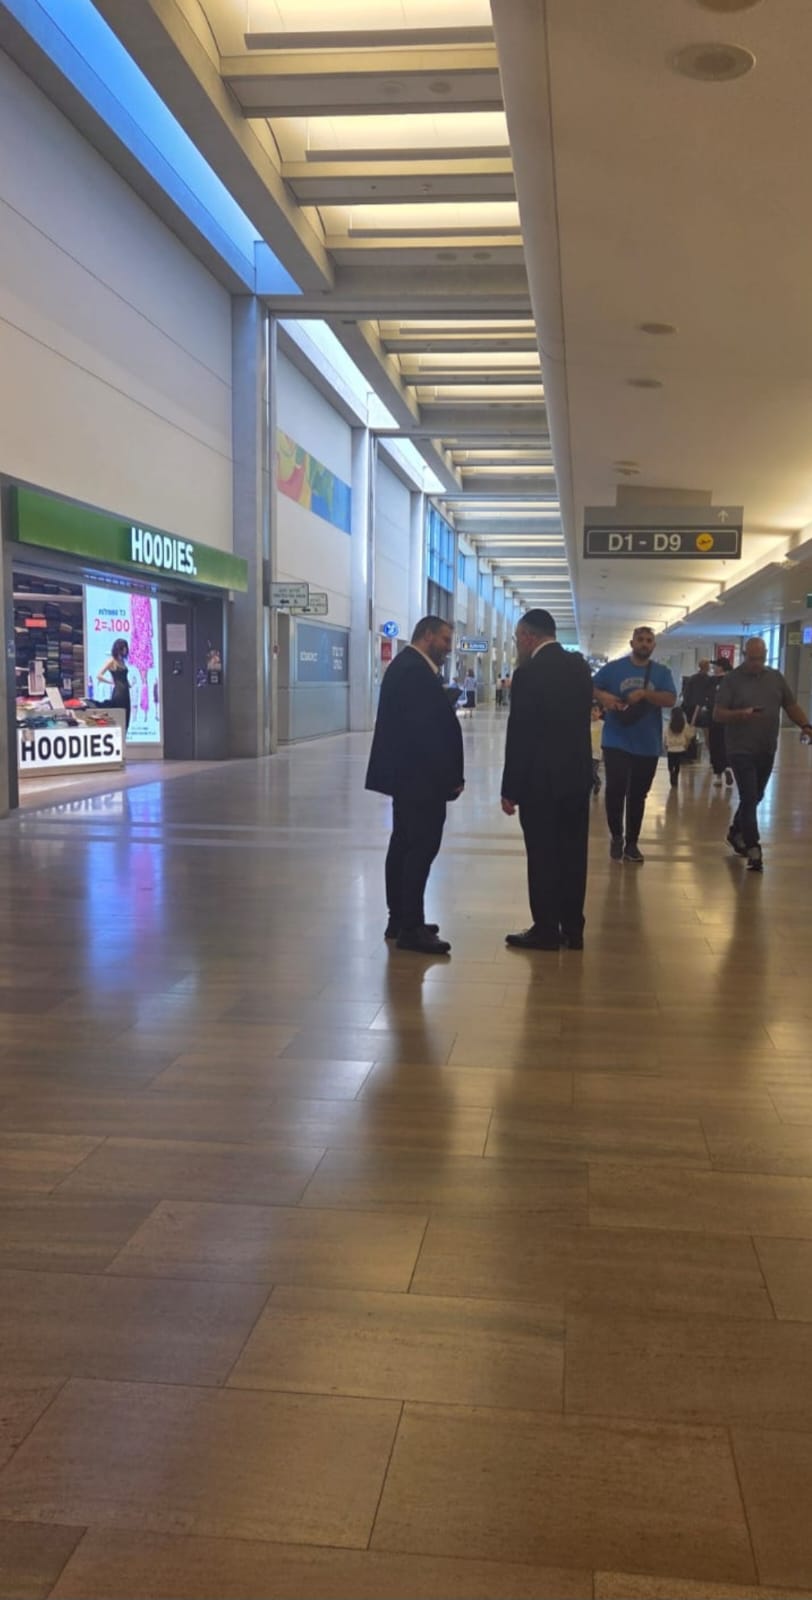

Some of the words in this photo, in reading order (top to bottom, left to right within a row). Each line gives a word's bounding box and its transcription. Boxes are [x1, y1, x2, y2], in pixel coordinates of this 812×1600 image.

[131, 527, 197, 575] HOODIES.
[608, 533, 633, 551] D1
[653, 533, 681, 551] D9
[21, 733, 120, 761] HOODIES.
